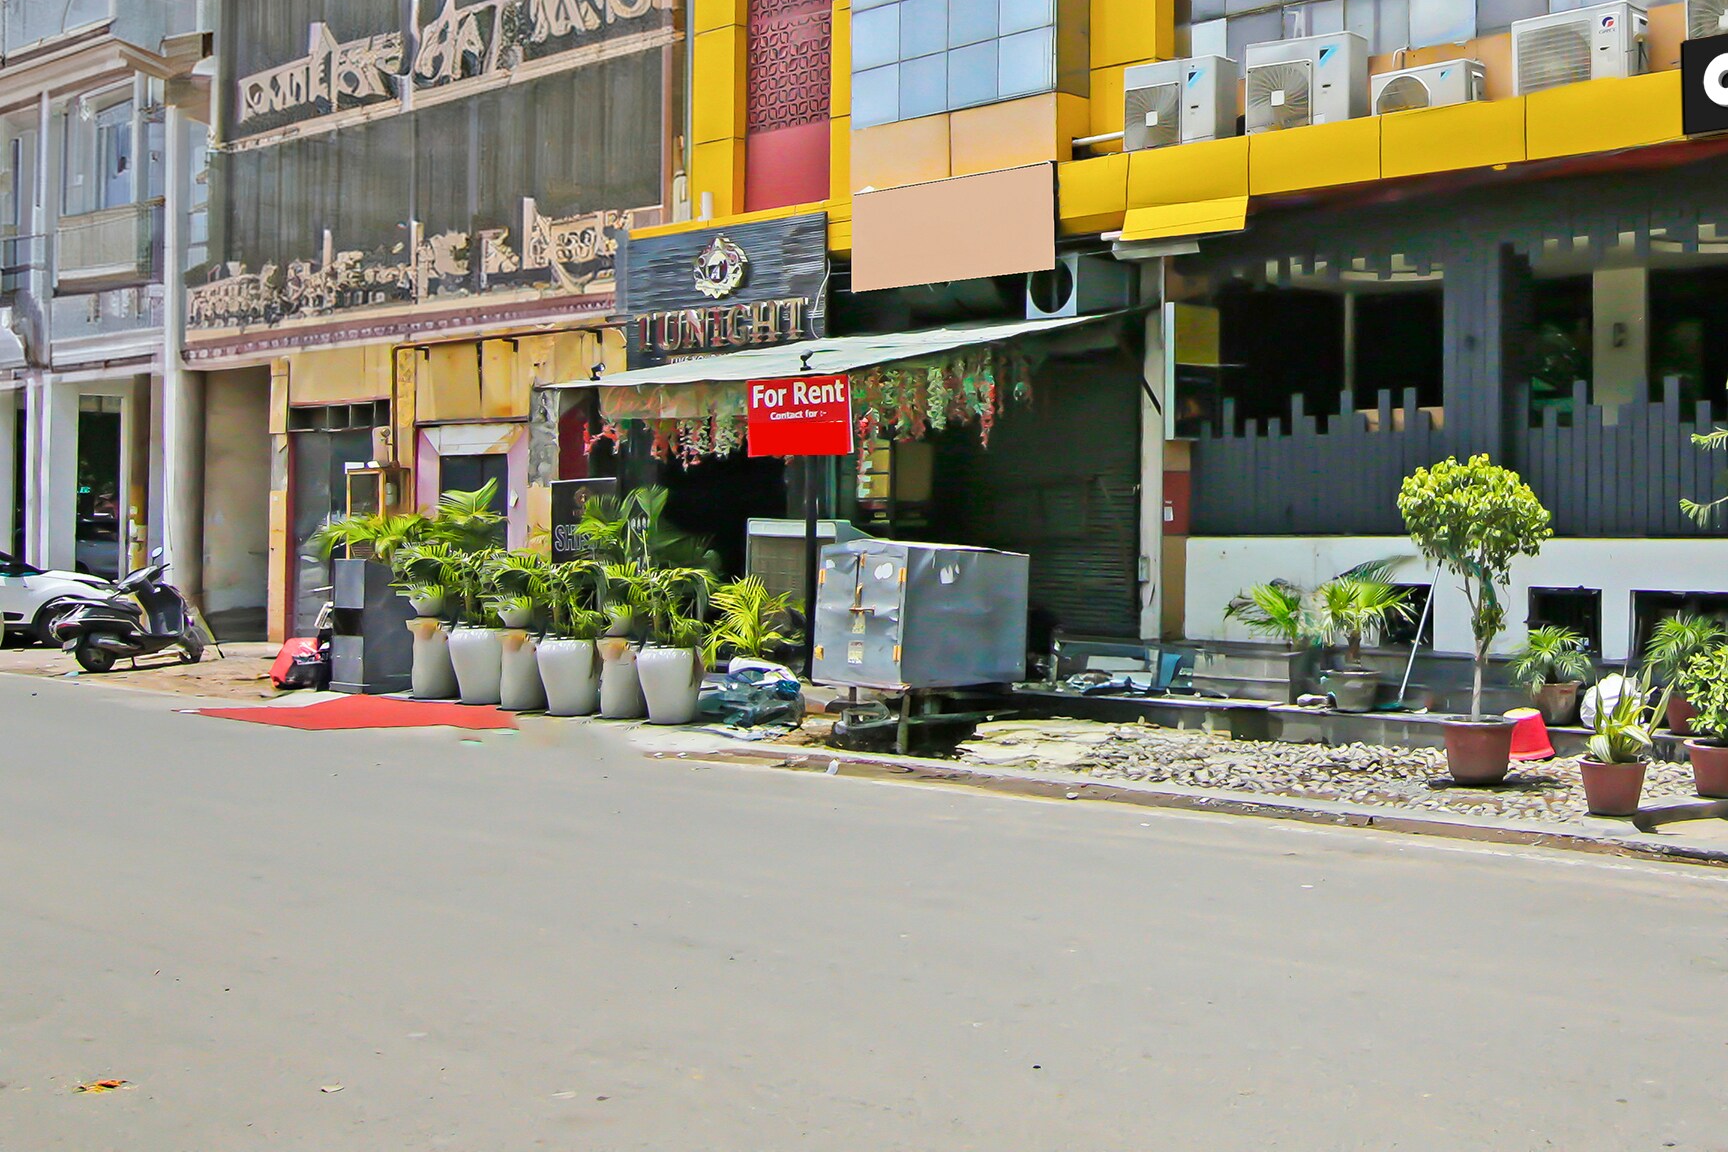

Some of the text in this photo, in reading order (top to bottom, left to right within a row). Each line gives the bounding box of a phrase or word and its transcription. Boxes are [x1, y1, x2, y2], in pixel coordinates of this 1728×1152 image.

[752, 379, 845, 409] For Rent
[770, 410, 803, 421] Contact
